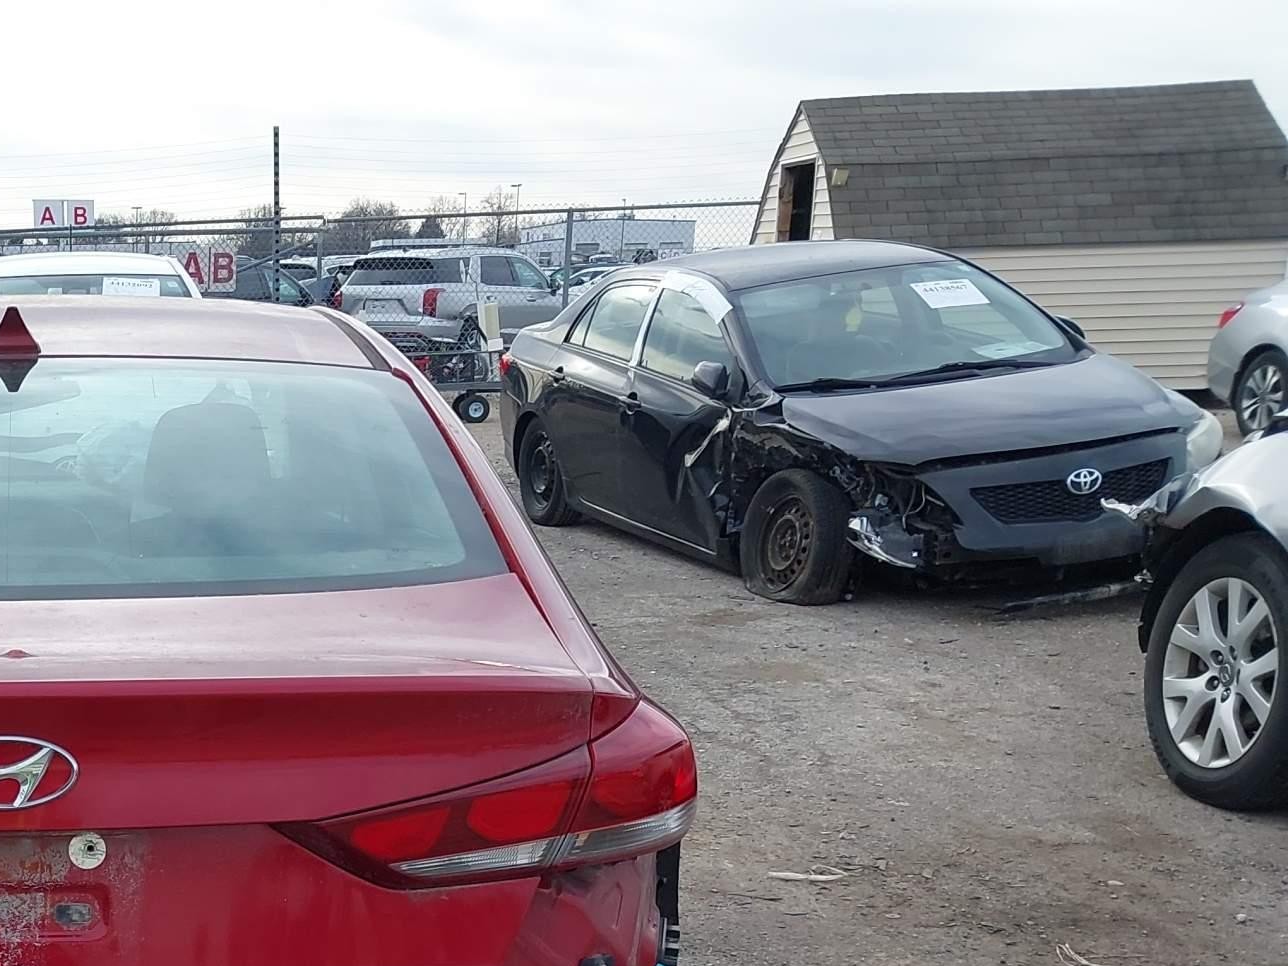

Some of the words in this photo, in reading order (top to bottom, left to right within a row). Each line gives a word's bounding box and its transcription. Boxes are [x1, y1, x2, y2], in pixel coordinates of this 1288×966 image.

[40, 206, 56, 225] A
[73, 206, 88, 225] B
[184, 251, 204, 285] A
[213, 252, 233, 284] B
